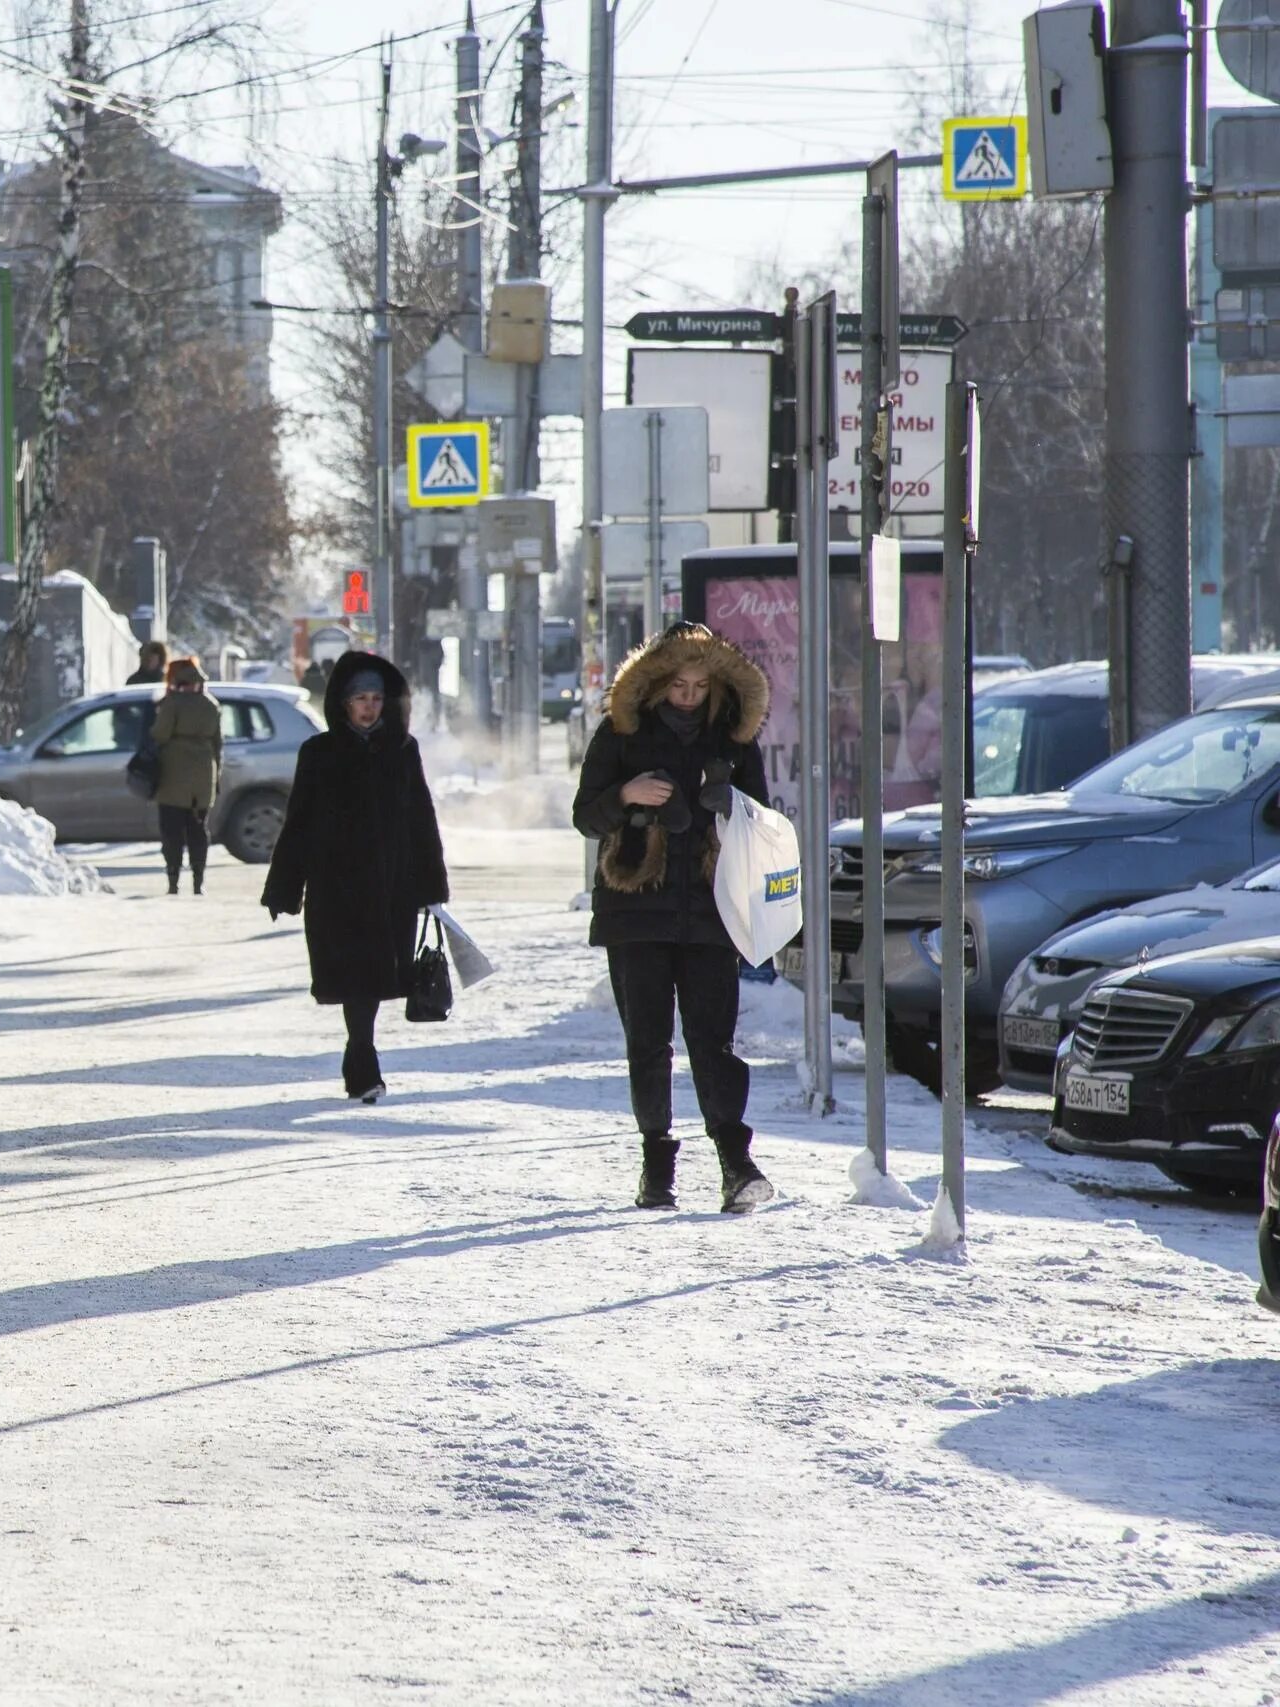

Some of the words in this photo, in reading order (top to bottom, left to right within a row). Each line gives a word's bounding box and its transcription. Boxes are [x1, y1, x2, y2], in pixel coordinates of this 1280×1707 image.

[647, 319, 672, 335] ул.
[677, 317, 762, 335] Мичурина
[1104, 1083, 1127, 1103] 154
